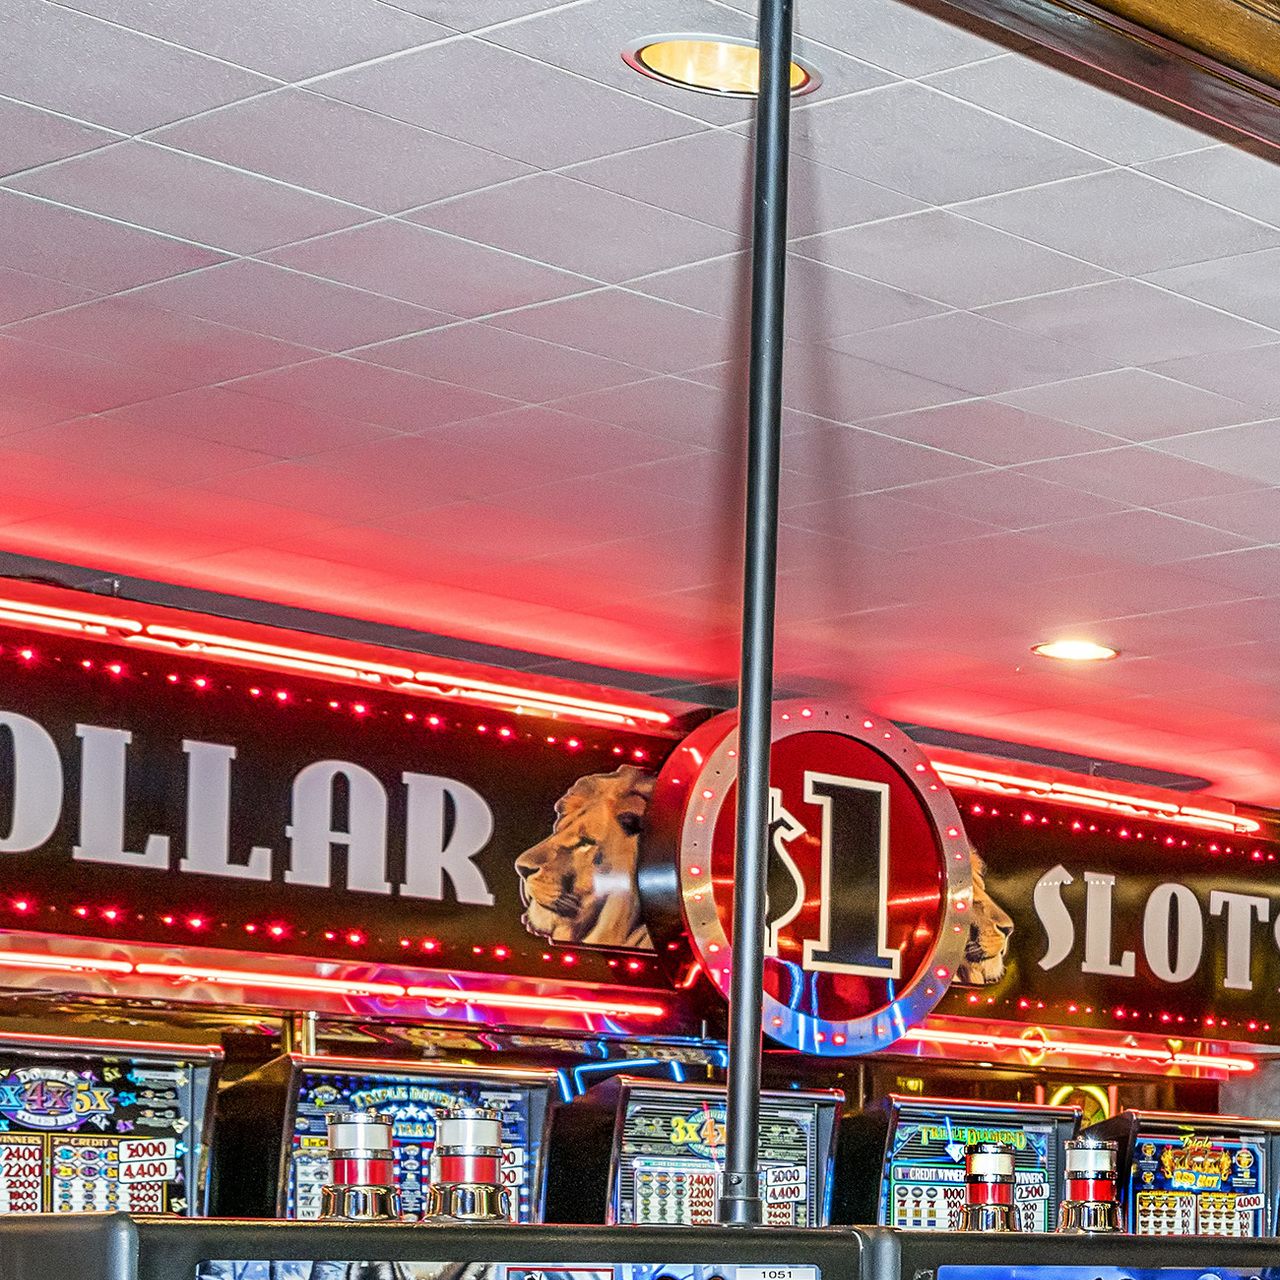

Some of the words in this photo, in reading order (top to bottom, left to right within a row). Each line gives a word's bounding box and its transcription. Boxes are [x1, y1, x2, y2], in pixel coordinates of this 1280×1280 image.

[671, 1116, 699, 1145] 3x
[4, 1147, 42, 1161] 2400
[126, 1142, 166, 1157] 5000
[4, 1164, 42, 1178] 2200
[7, 1180, 39, 1189] 2000
[688, 1174, 714, 1187] 2400
[689, 1188, 714, 1200] 2200
[943, 1188, 965, 1199] 1000
[1022, 1202, 1038, 1211] 200
[1024, 1221, 1035, 1230] 40
[760, 1271, 793, 1279] 1051
